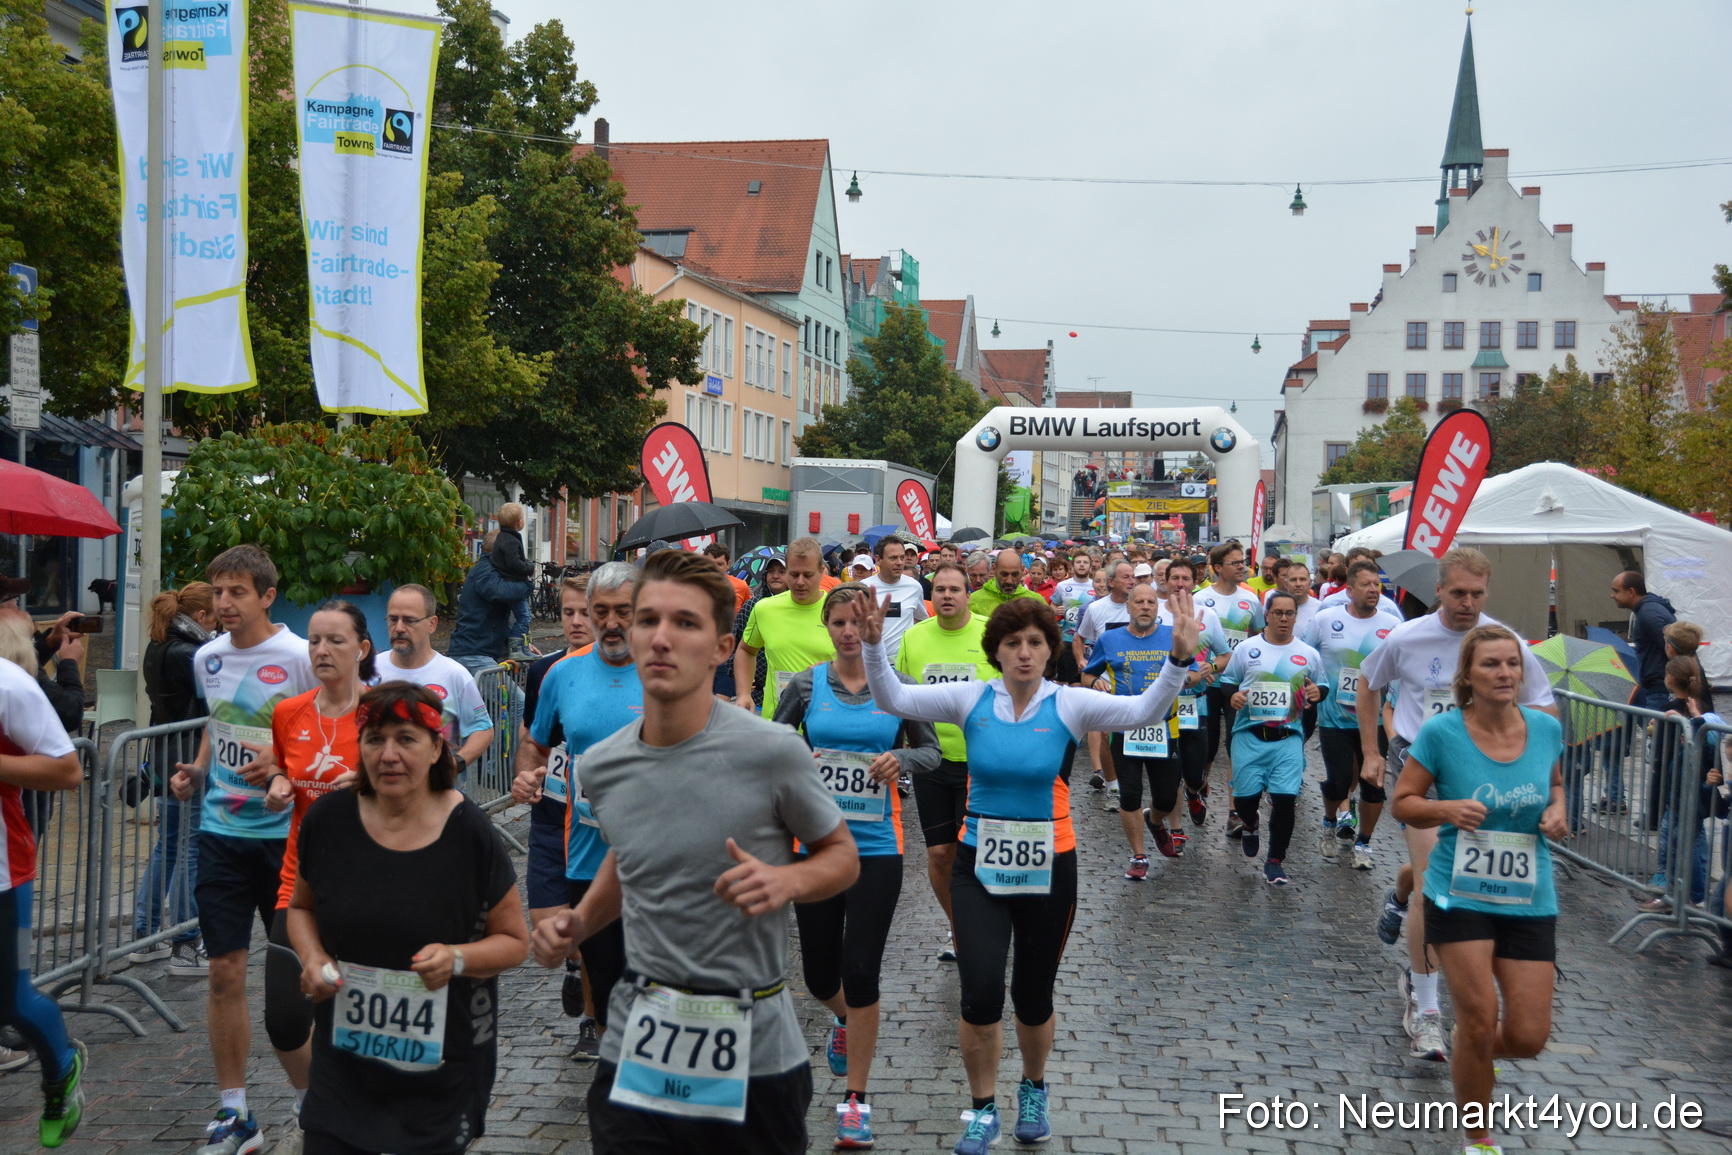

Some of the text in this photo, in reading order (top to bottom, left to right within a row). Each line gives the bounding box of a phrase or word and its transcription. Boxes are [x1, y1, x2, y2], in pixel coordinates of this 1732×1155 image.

[307, 100, 374, 117] Kampagne
[307, 113, 379, 134] Fairtrade
[337, 136, 375, 151] Towns
[383, 142, 411, 153] FAIRTRADE
[307, 219, 388, 247] Wir sind
[1010, 415, 1201, 442] BMW Laufsport
[1411, 430, 1480, 558] REWE
[1146, 501, 1169, 511] ZIEL
[1252, 488, 1265, 549] REWE
[1252, 691, 1287, 706] 2524
[1261, 708, 1276, 716] Marc
[1129, 727, 1163, 743] 2038
[218, 738, 254, 768] 206
[1135, 744, 1157, 752] Norbert
[820, 765, 880, 795] 2584
[836, 797, 866, 811] ristina
[984, 837, 1046, 867] 2585
[1463, 847, 1529, 879] 2103
[995, 872, 1029, 886] Margit
[1479, 881, 1507, 894] Petra
[384, 974, 425, 988] BOC
[346, 988, 435, 1035] 3044
[677, 998, 739, 1017] BOCK
[342, 1030, 425, 1063] SIGRID
[635, 1014, 737, 1072] 2778
[664, 1078, 691, 1099] Nic
